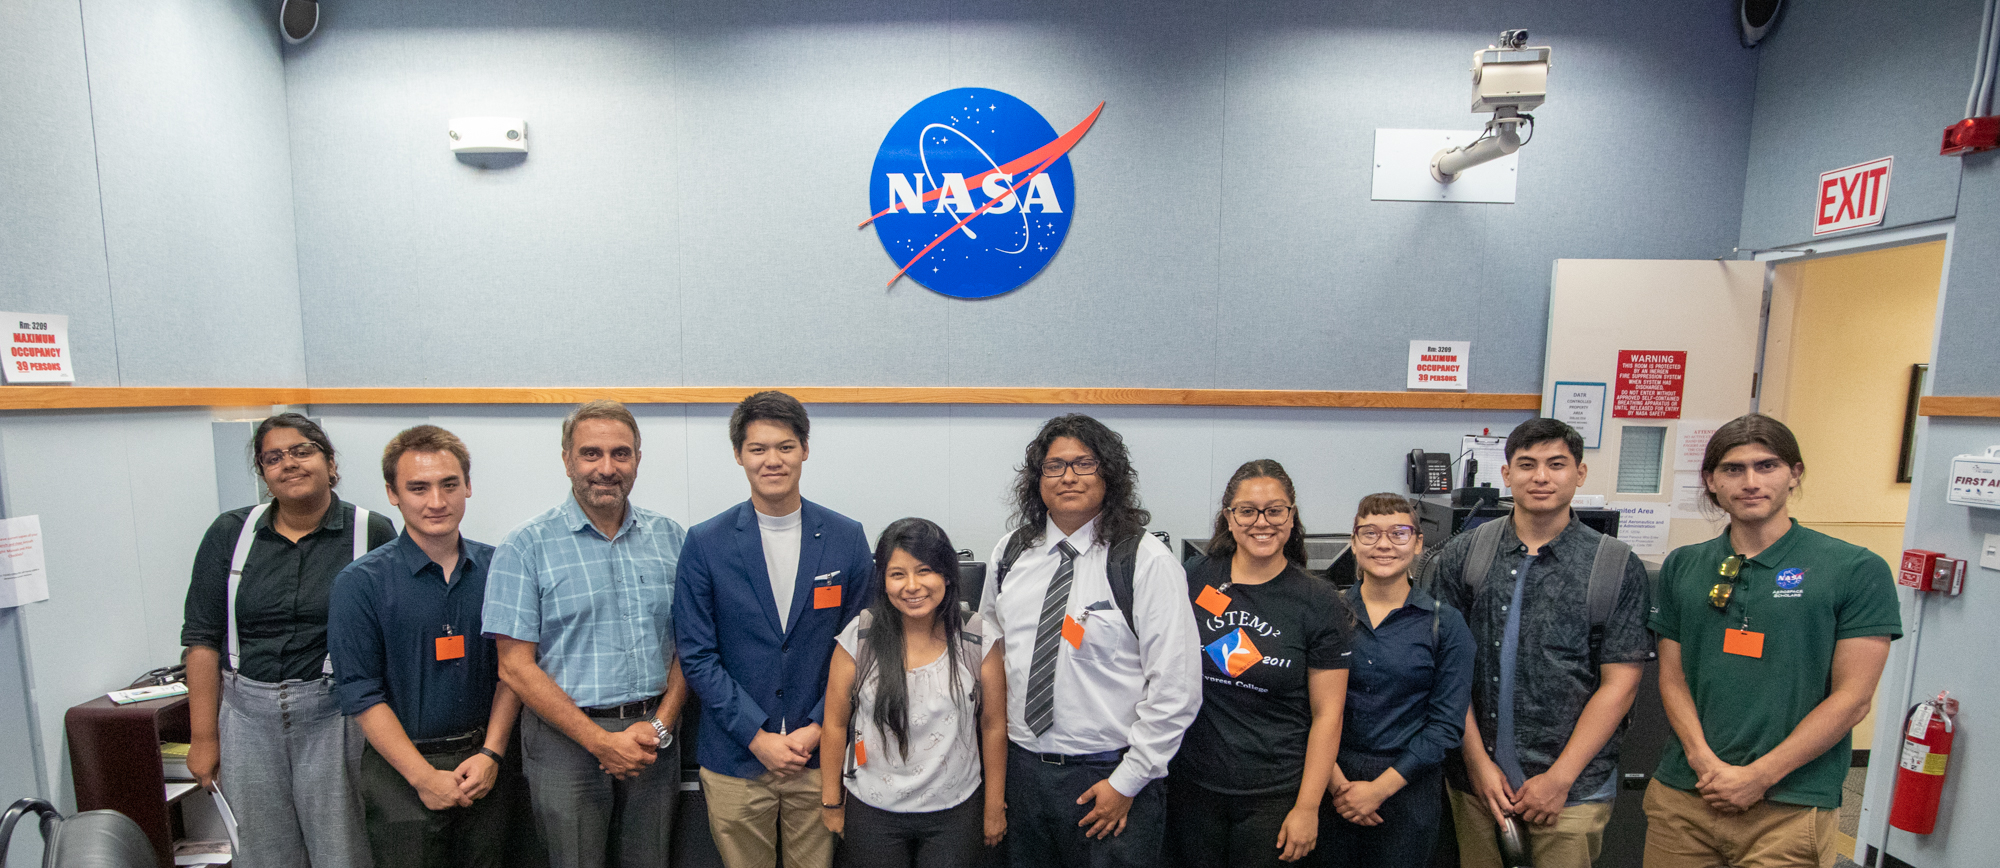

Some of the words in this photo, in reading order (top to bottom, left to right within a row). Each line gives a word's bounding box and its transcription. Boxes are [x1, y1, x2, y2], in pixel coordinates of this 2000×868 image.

[885, 172, 1064, 216] NASA
[1818, 166, 1888, 226] EXIT
[32, 322, 48, 330] 3209
[13, 333, 56, 344] MAXIMUM
[11, 347, 61, 357] OCCUPANCY
[1421, 354, 1457, 362] MAXIMUM
[1631, 354, 1674, 363] WARNING
[16, 361, 29, 371] 39
[30, 363, 61, 371] PERSONS
[1416, 364, 1460, 372] OCCUPANCY
[1955, 476, 1987, 486] FIRST
[1987, 479, 2000, 488] AI
[1262, 656, 1291, 668] 2011
[1202, 674, 1232, 685] ypress
[1235, 681, 1269, 693] College
